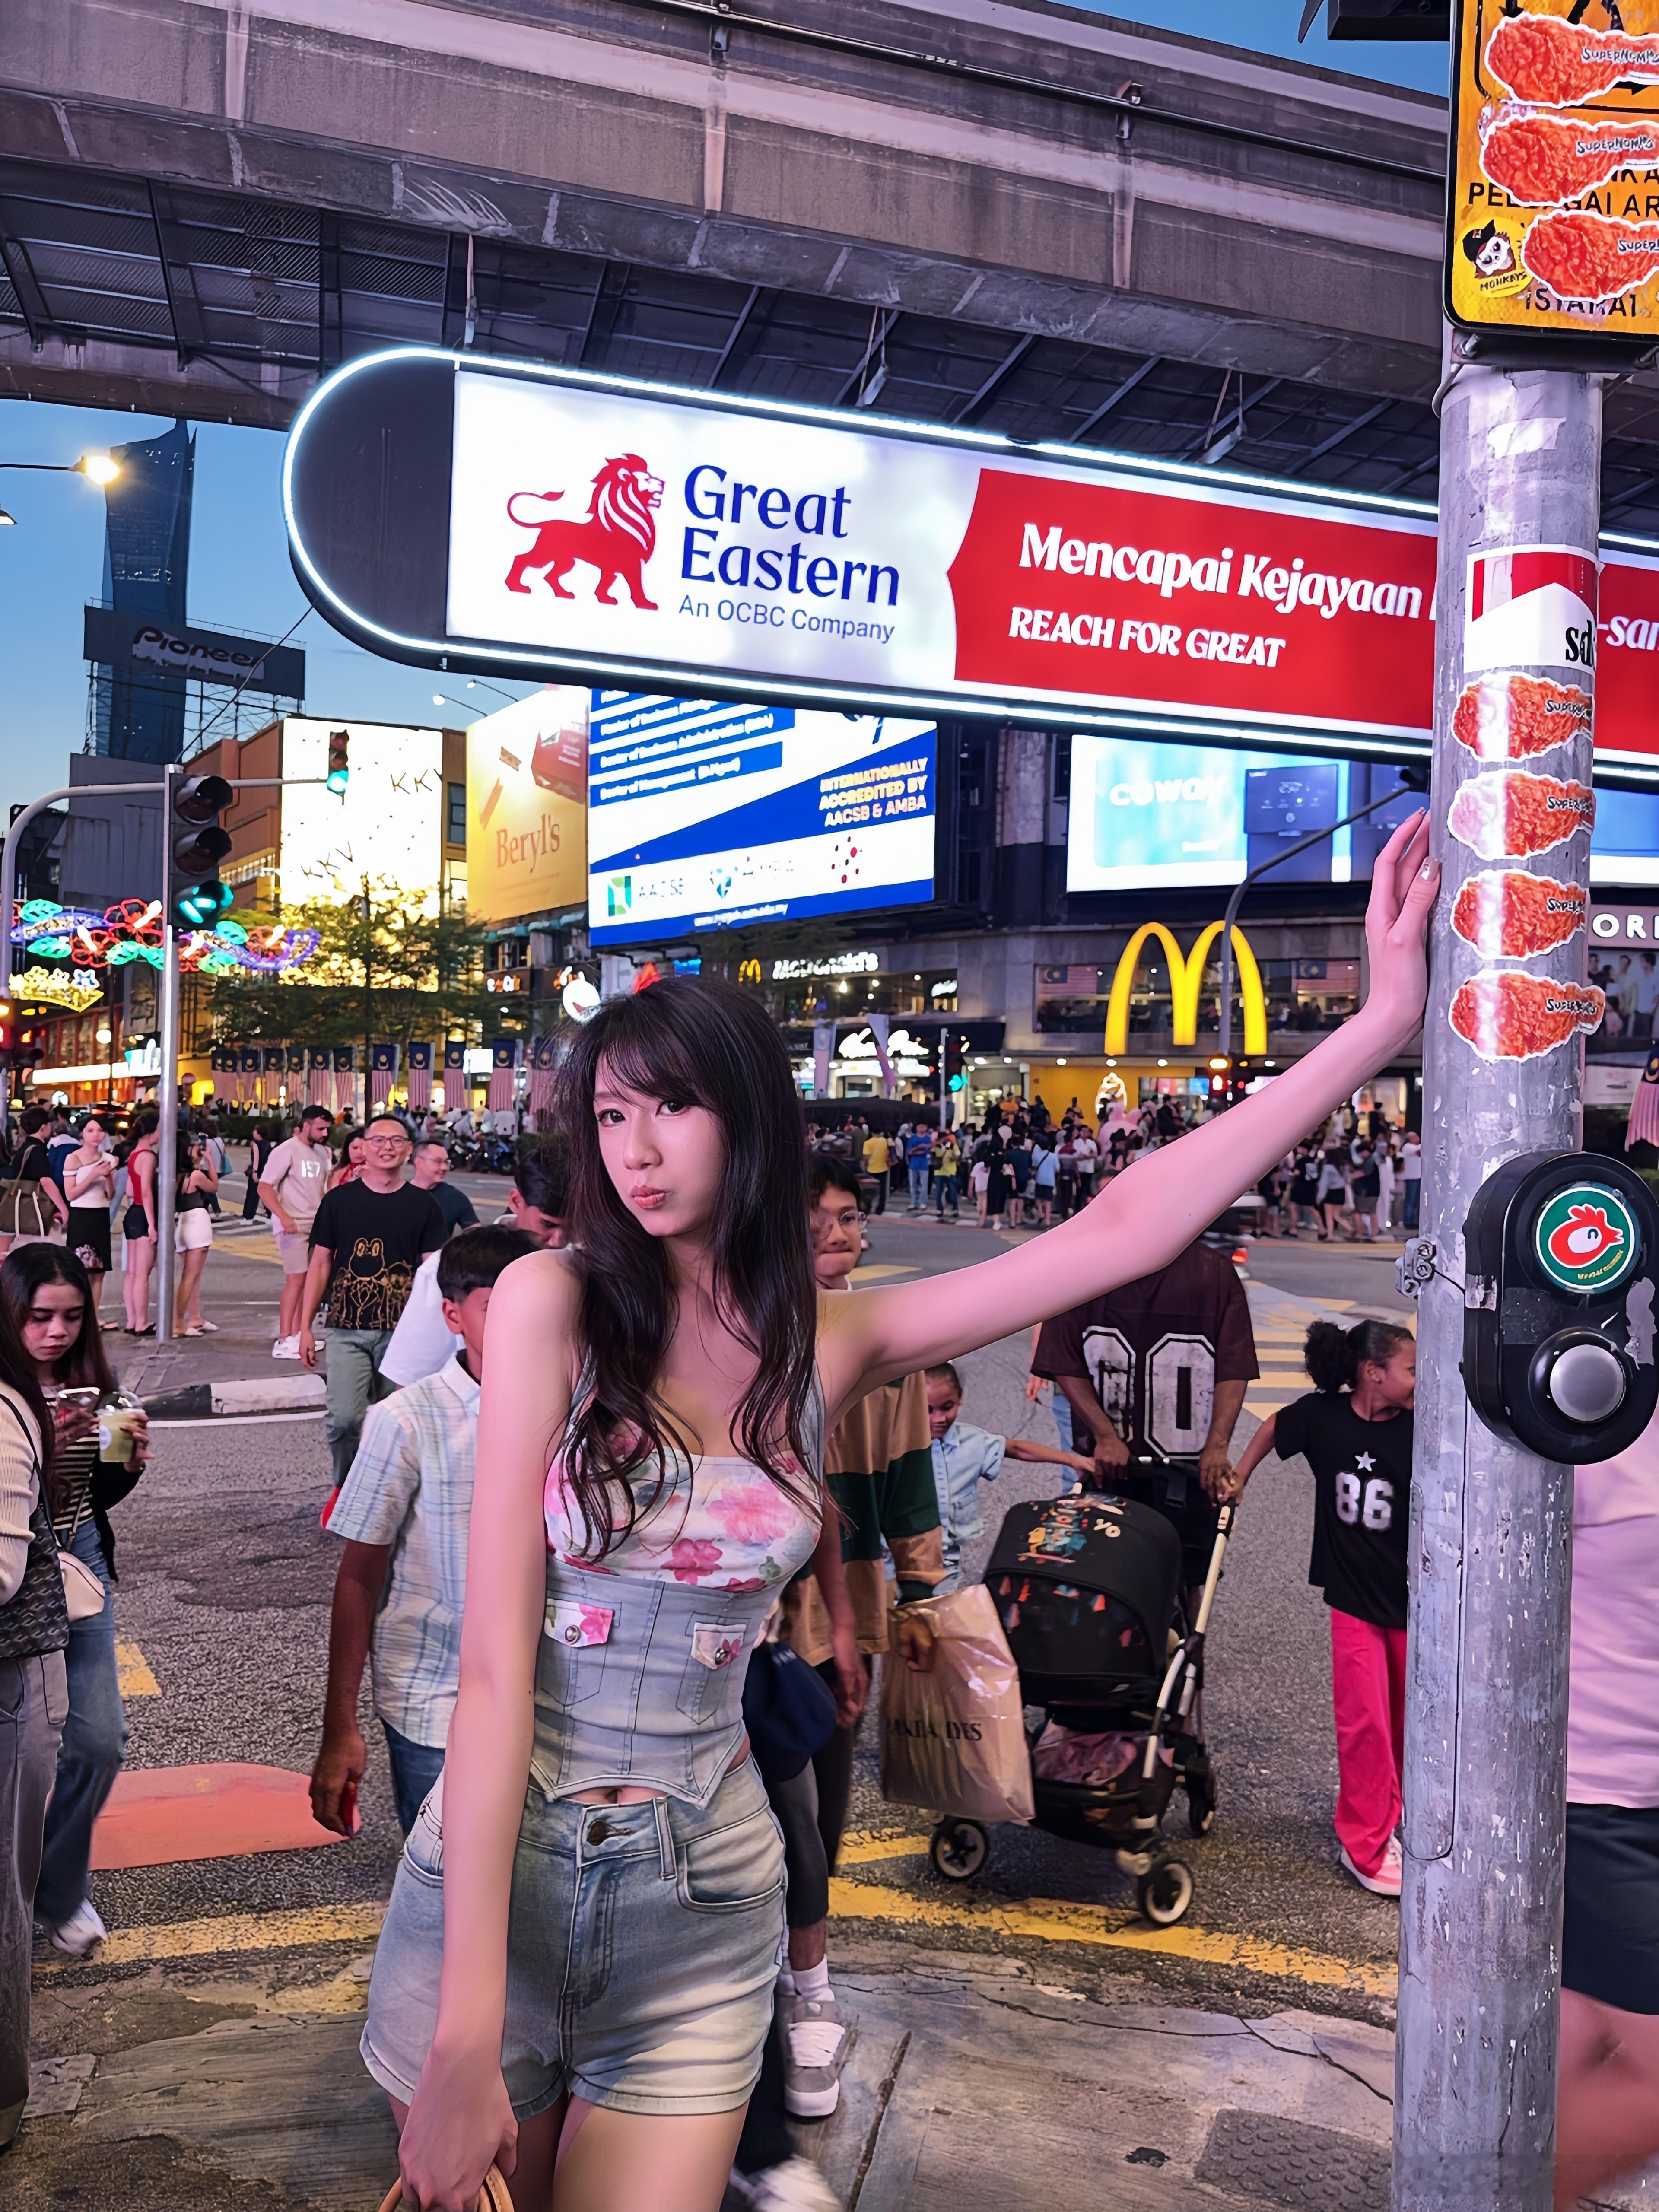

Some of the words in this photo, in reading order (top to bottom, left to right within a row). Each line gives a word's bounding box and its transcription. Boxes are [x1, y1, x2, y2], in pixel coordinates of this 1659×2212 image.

[1619, 238, 1659, 251] SUPER
[684, 464, 852, 538] Great
[681, 526, 899, 606] Eastern
[1018, 523, 1234, 599] Mencapai
[1237, 553, 1423, 619] Kejayaan
[679, 595, 709, 618] An
[718, 599, 785, 627] OCBC
[791, 609, 895, 644] Company
[1008, 607, 1115, 649] REACH
[1119, 620, 1181, 656] FOR
[1185, 627, 1286, 667] GREAT
[885, 794, 927, 816] AMBA
[496, 814, 560, 874] Beryl's
[1335, 1471, 1395, 1532] 86
